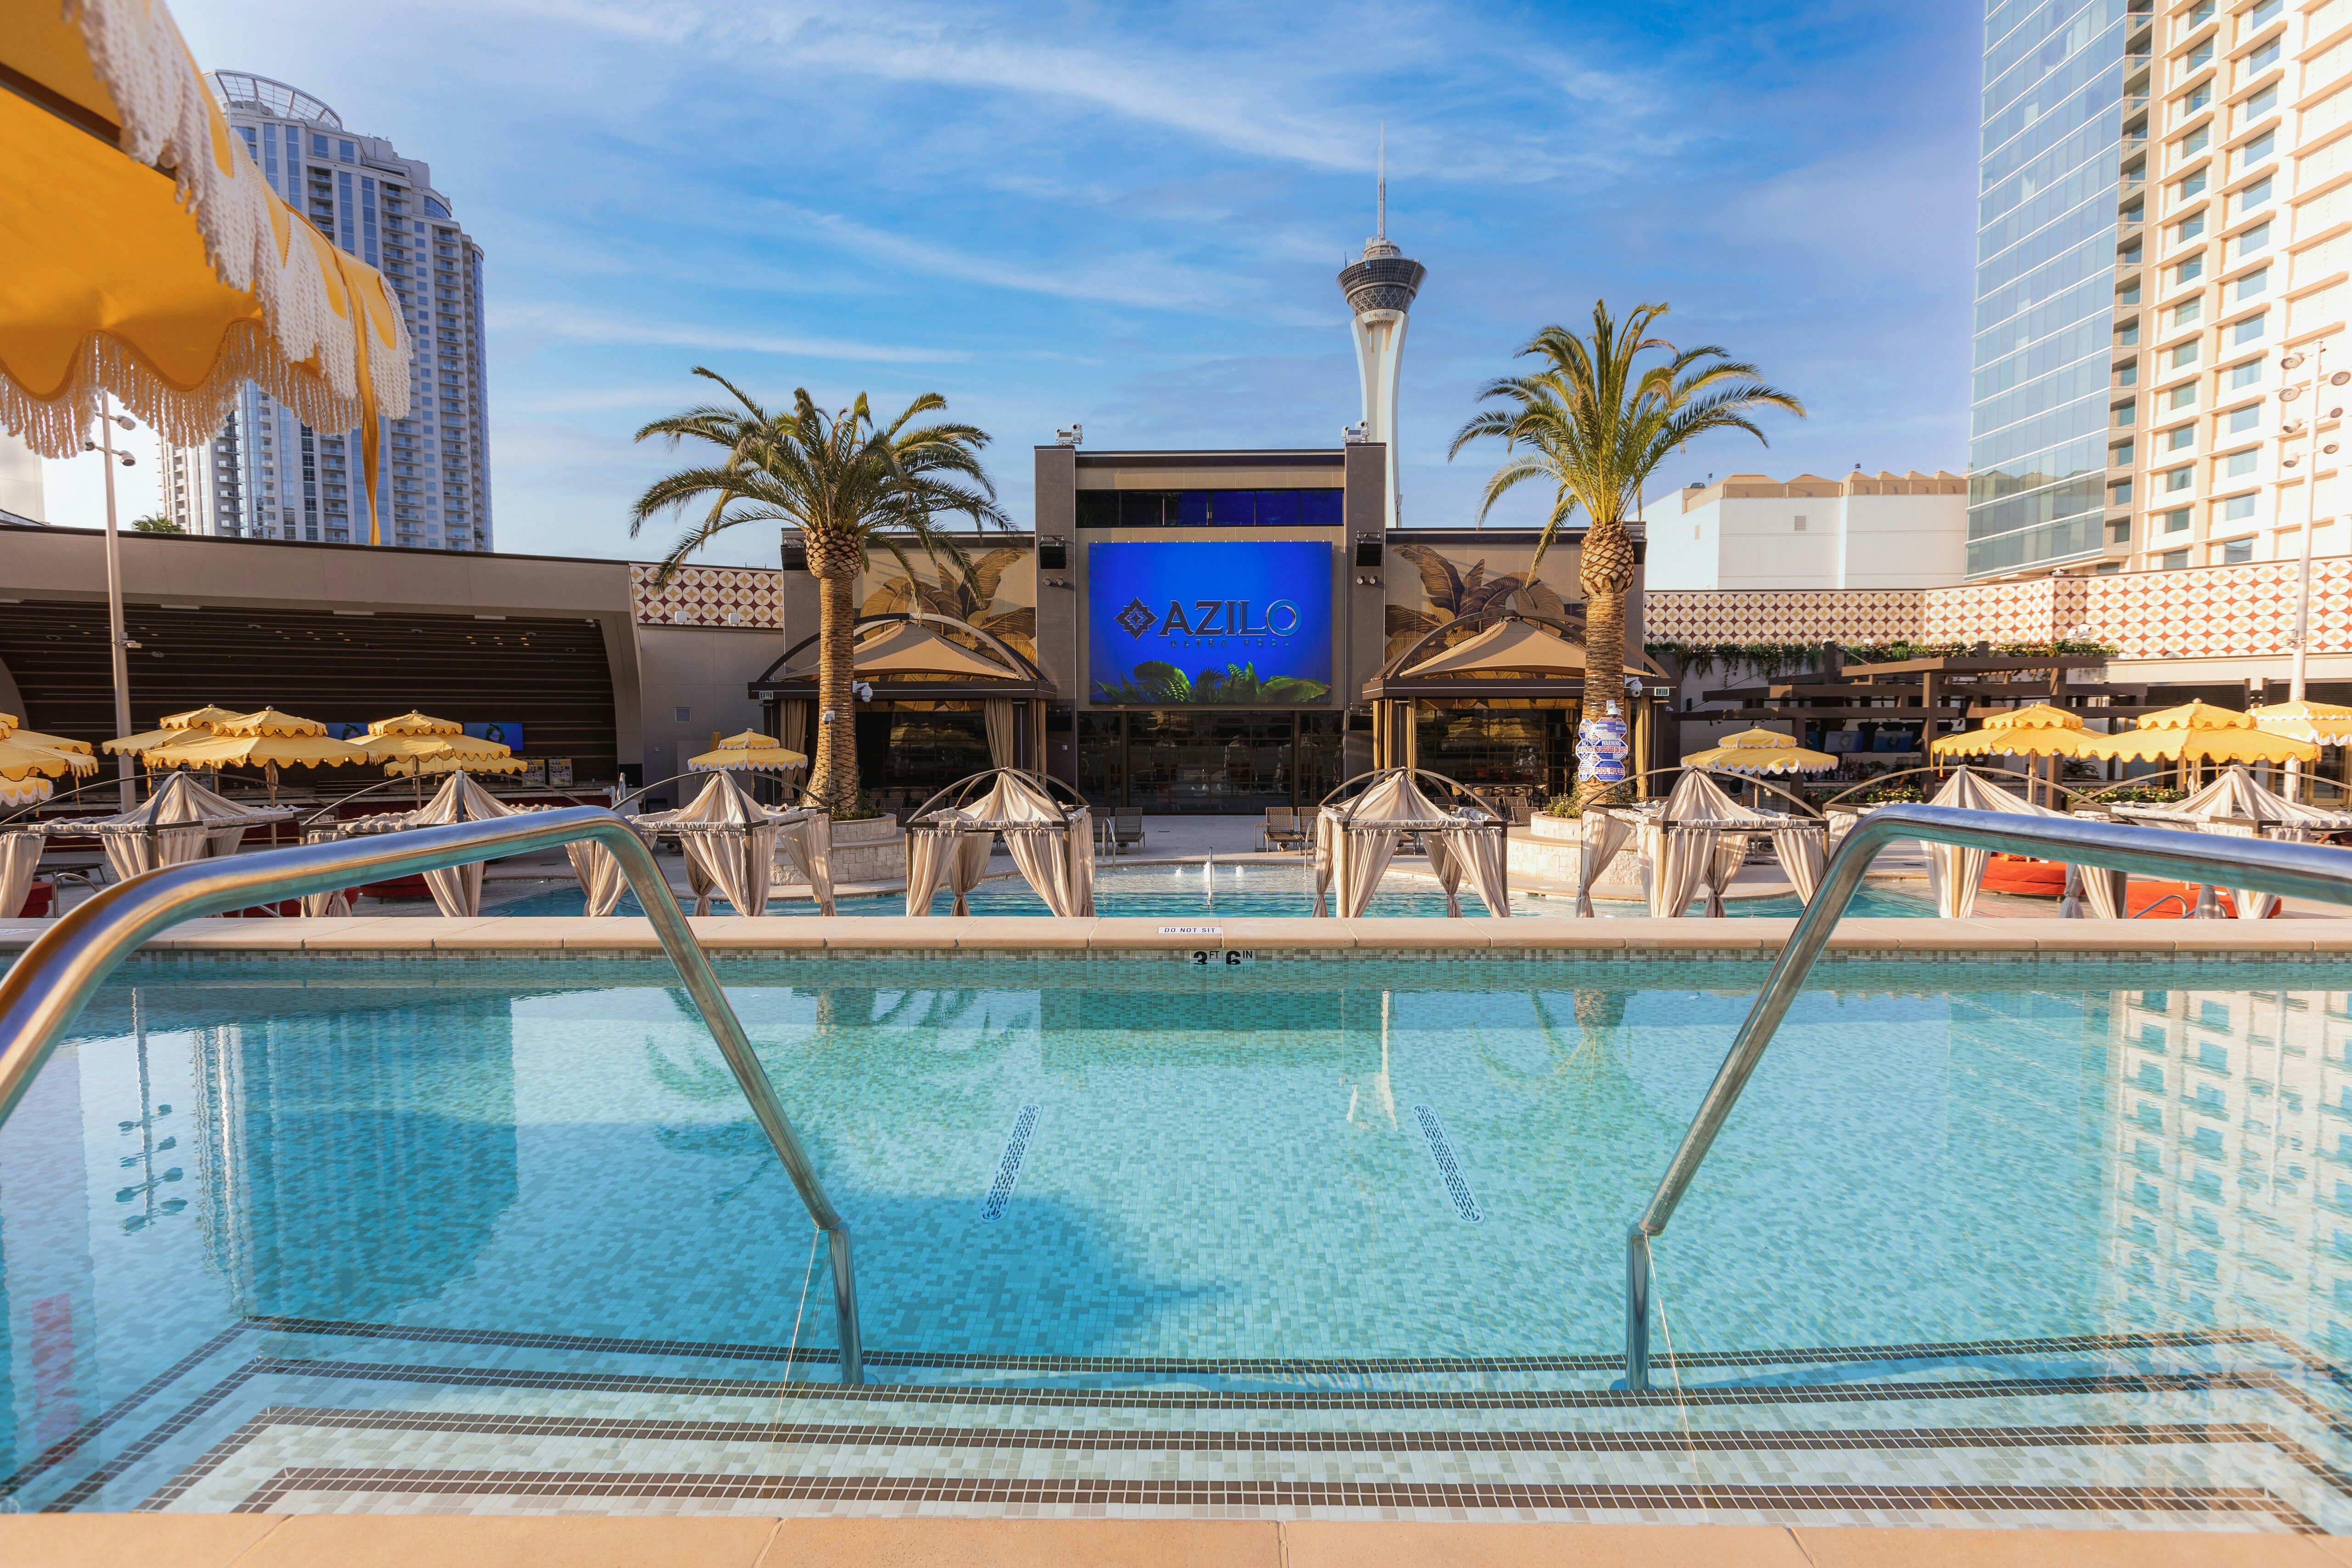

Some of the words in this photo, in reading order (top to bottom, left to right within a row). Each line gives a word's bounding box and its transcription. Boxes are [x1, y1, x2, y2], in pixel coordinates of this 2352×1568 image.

[1158, 599, 1302, 636] AZILO
[1193, 951, 1208, 965] 3
[1210, 951, 1220, 959] FT
[1226, 950, 1241, 965] 6
